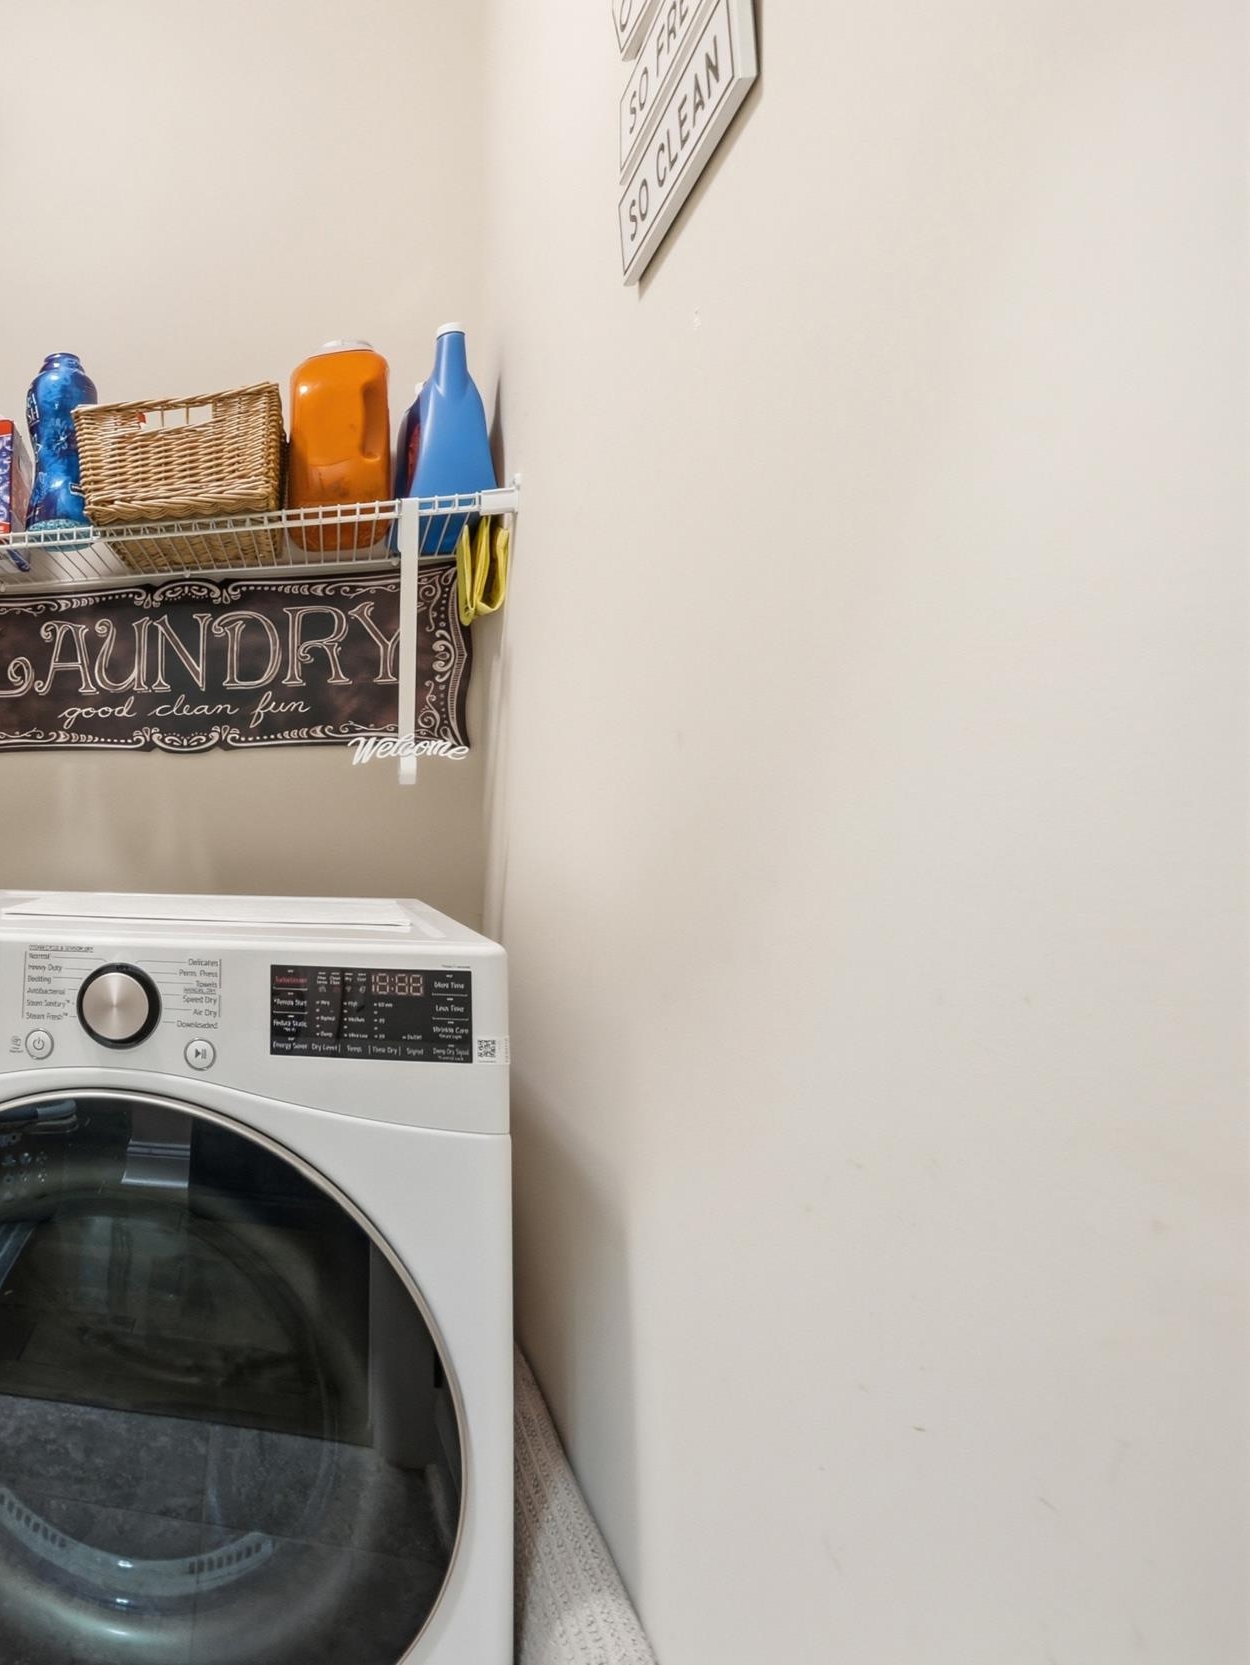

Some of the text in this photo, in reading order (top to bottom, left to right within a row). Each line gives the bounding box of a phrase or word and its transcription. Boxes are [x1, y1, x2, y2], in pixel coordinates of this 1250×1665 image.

[628, 66, 649, 135] SO
[628, 34, 720, 242] SO CLEAN
[57, 690, 311, 730] good clean fun
[347, 732, 471, 766] Welcome
